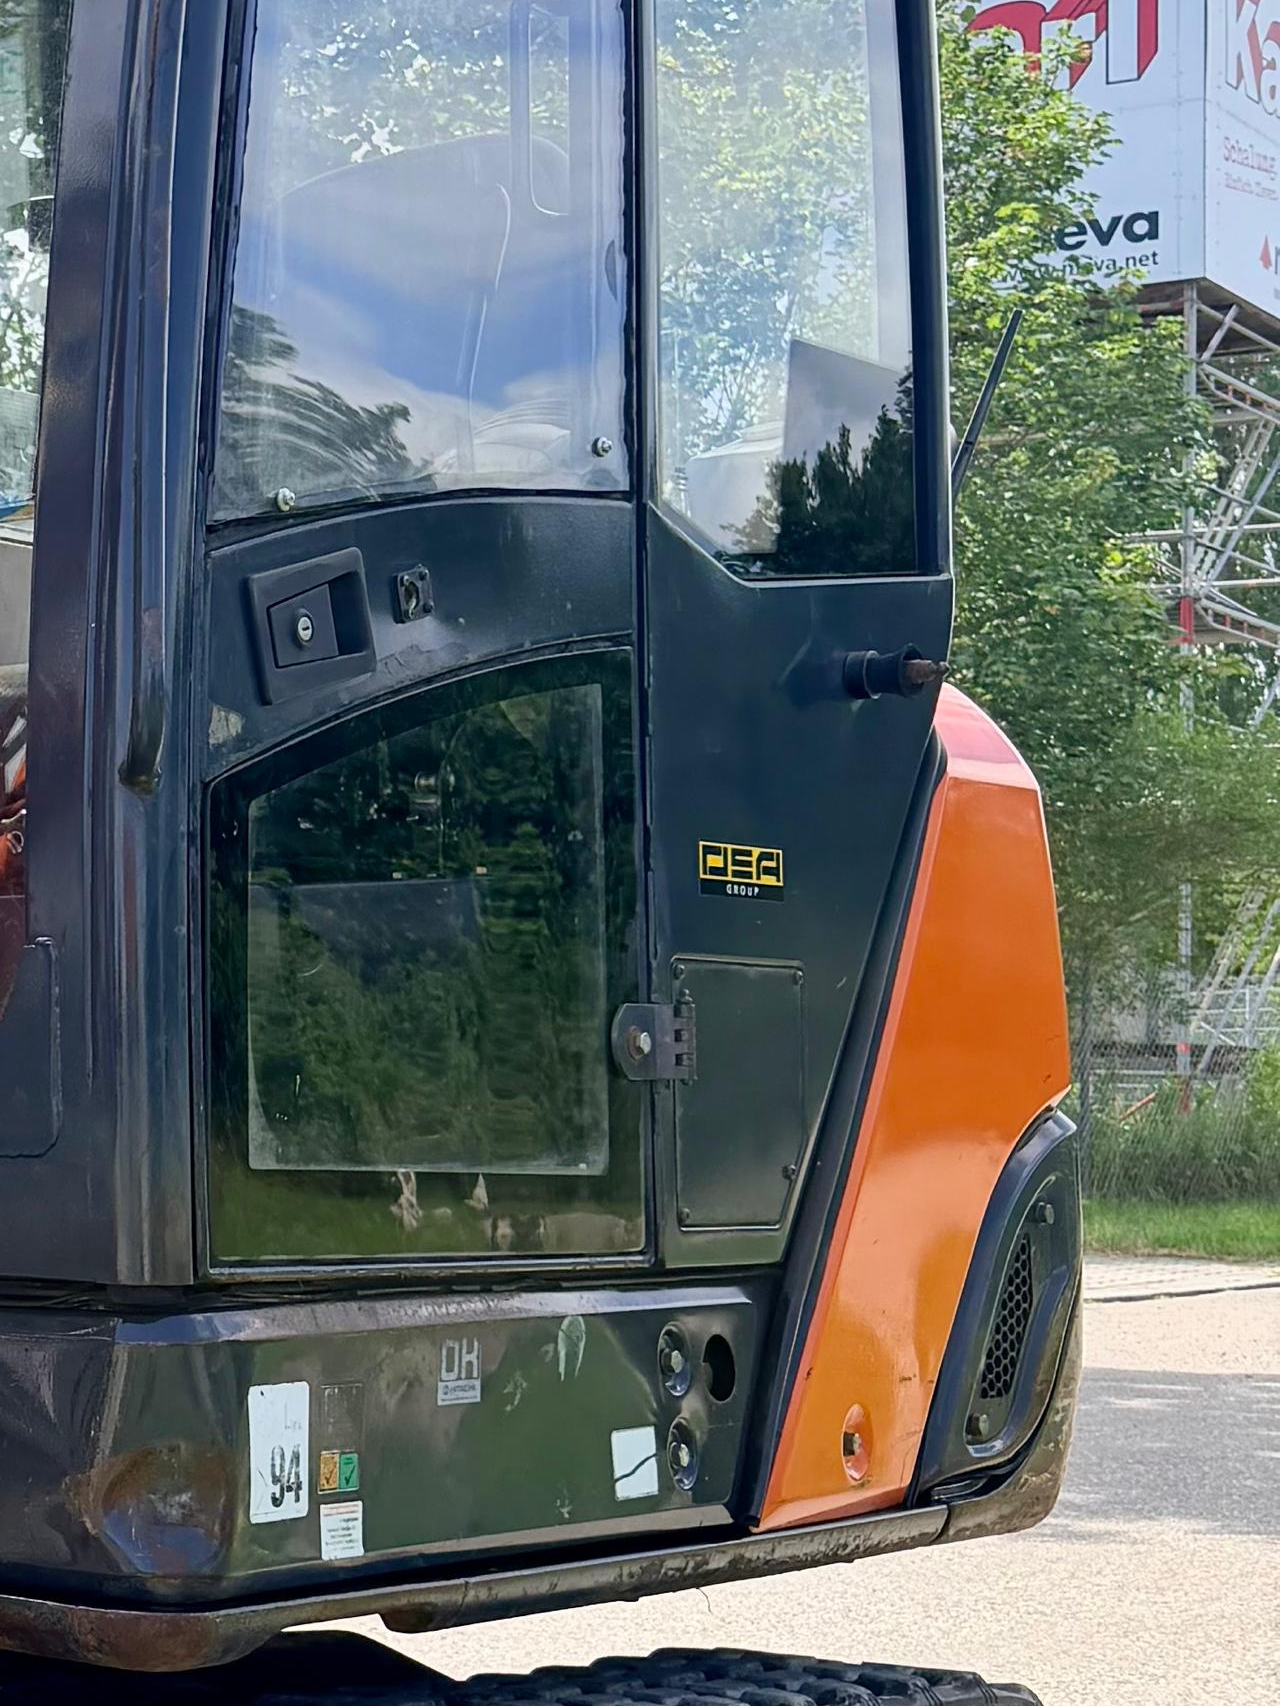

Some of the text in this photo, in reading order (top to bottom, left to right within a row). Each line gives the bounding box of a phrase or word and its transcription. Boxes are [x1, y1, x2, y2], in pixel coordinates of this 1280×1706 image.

[1054, 210, 1160, 252] eva
[726, 883, 760, 897] GROUP
[441, 1337, 479, 1381] OK
[270, 1443, 303, 1508] 94
